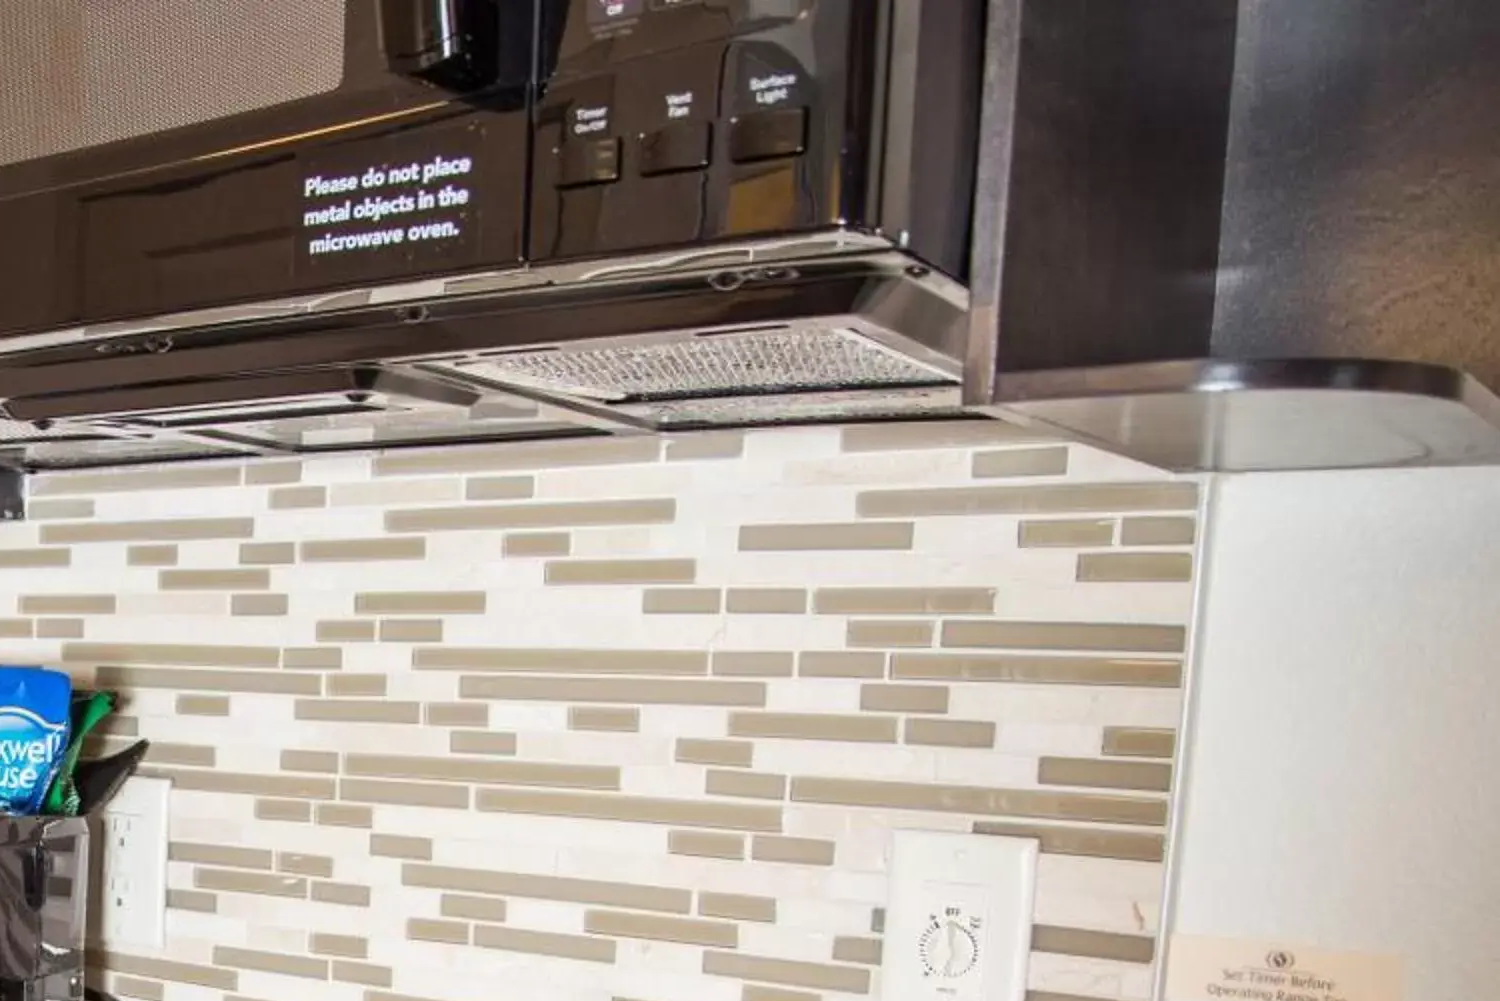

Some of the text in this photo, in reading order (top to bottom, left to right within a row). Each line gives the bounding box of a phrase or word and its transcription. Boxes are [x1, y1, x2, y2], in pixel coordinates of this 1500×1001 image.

[304, 155, 472, 197] Please do not place
[303, 184, 469, 226] metal objects in the
[309, 221, 460, 255] microwave oven.
[1221, 968, 1336, 991] Set Timer Before
